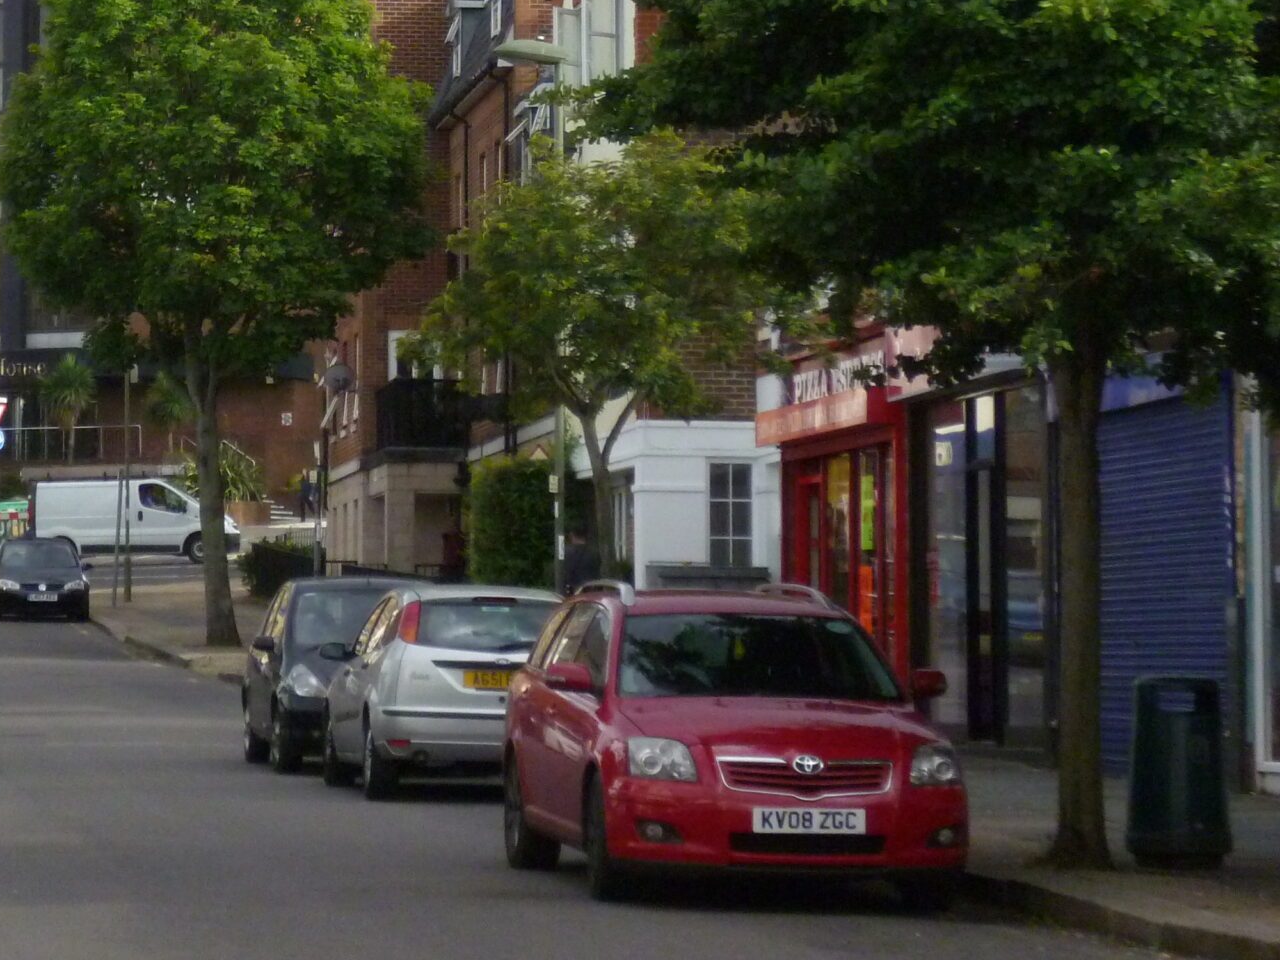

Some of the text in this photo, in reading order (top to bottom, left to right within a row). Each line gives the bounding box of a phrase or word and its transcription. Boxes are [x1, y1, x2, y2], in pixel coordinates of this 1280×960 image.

[793, 369, 829, 404] PIZZA
[761, 810, 857, 830] KV08 ZGC
